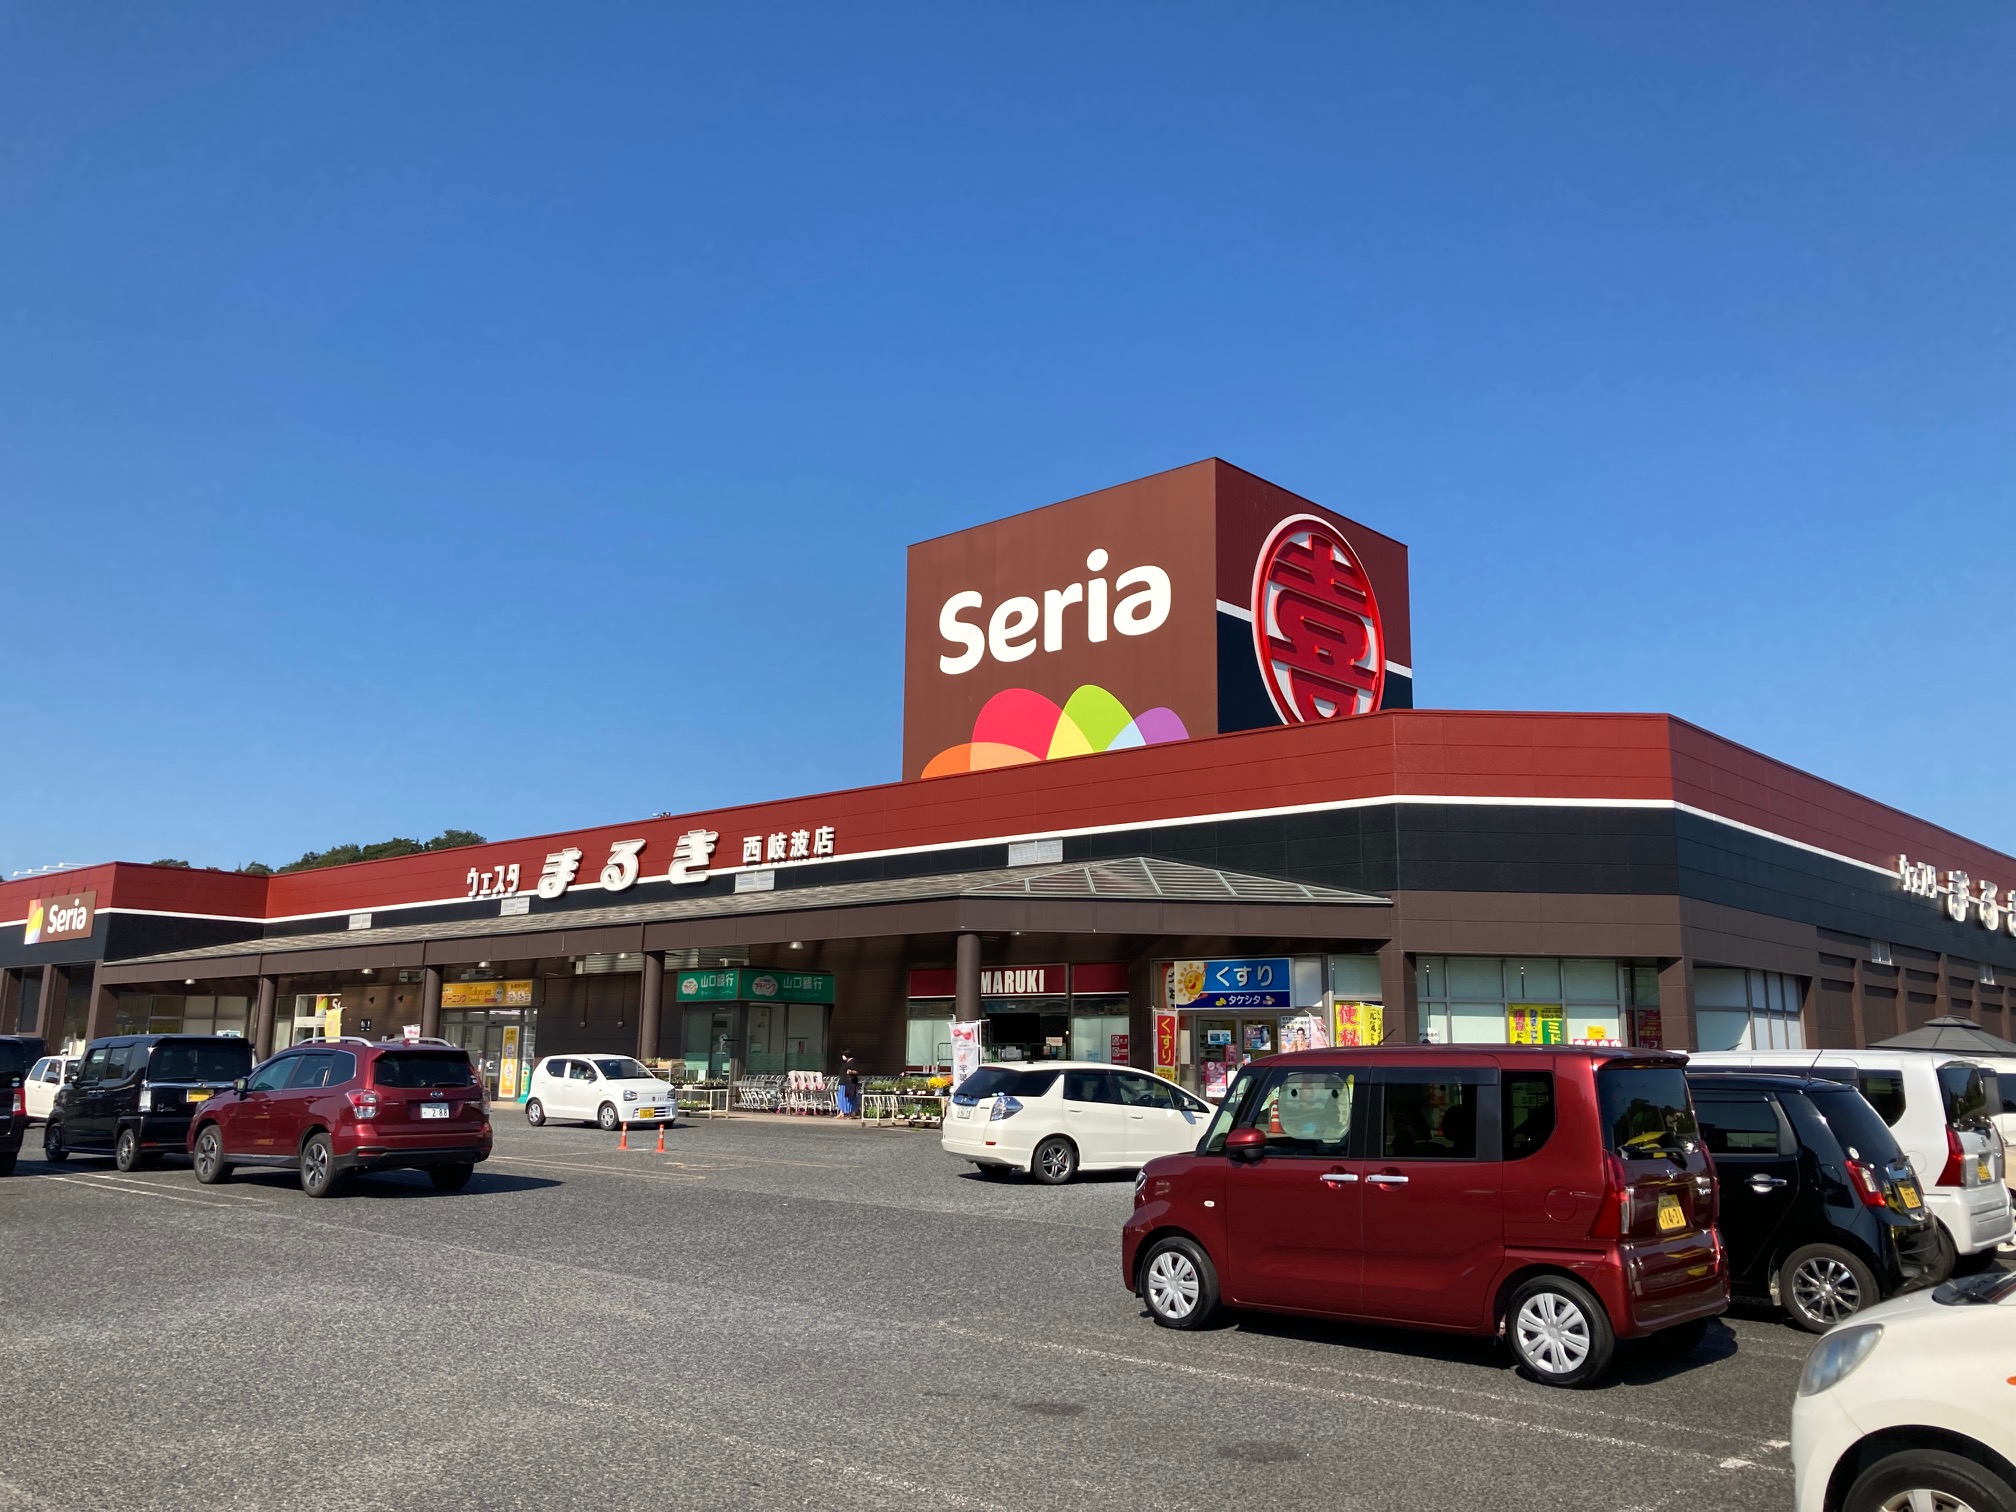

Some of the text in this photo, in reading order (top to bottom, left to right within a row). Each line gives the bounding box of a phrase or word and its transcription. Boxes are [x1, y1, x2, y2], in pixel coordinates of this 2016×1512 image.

[939, 548, 1172, 676] Seria
[537, 829, 720, 900] まるき
[742, 825, 836, 863] 西岐波店
[47, 898, 87, 934] Seria
[700, 973, 734, 988] 山口銀行
[783, 976, 824, 990] 山口銀行
[981, 969, 1045, 994] MARUKI
[1215, 965, 1274, 988] くすり
[1228, 994, 1261, 1005] タケシタ
[1160, 1017, 1173, 1064] くすり
